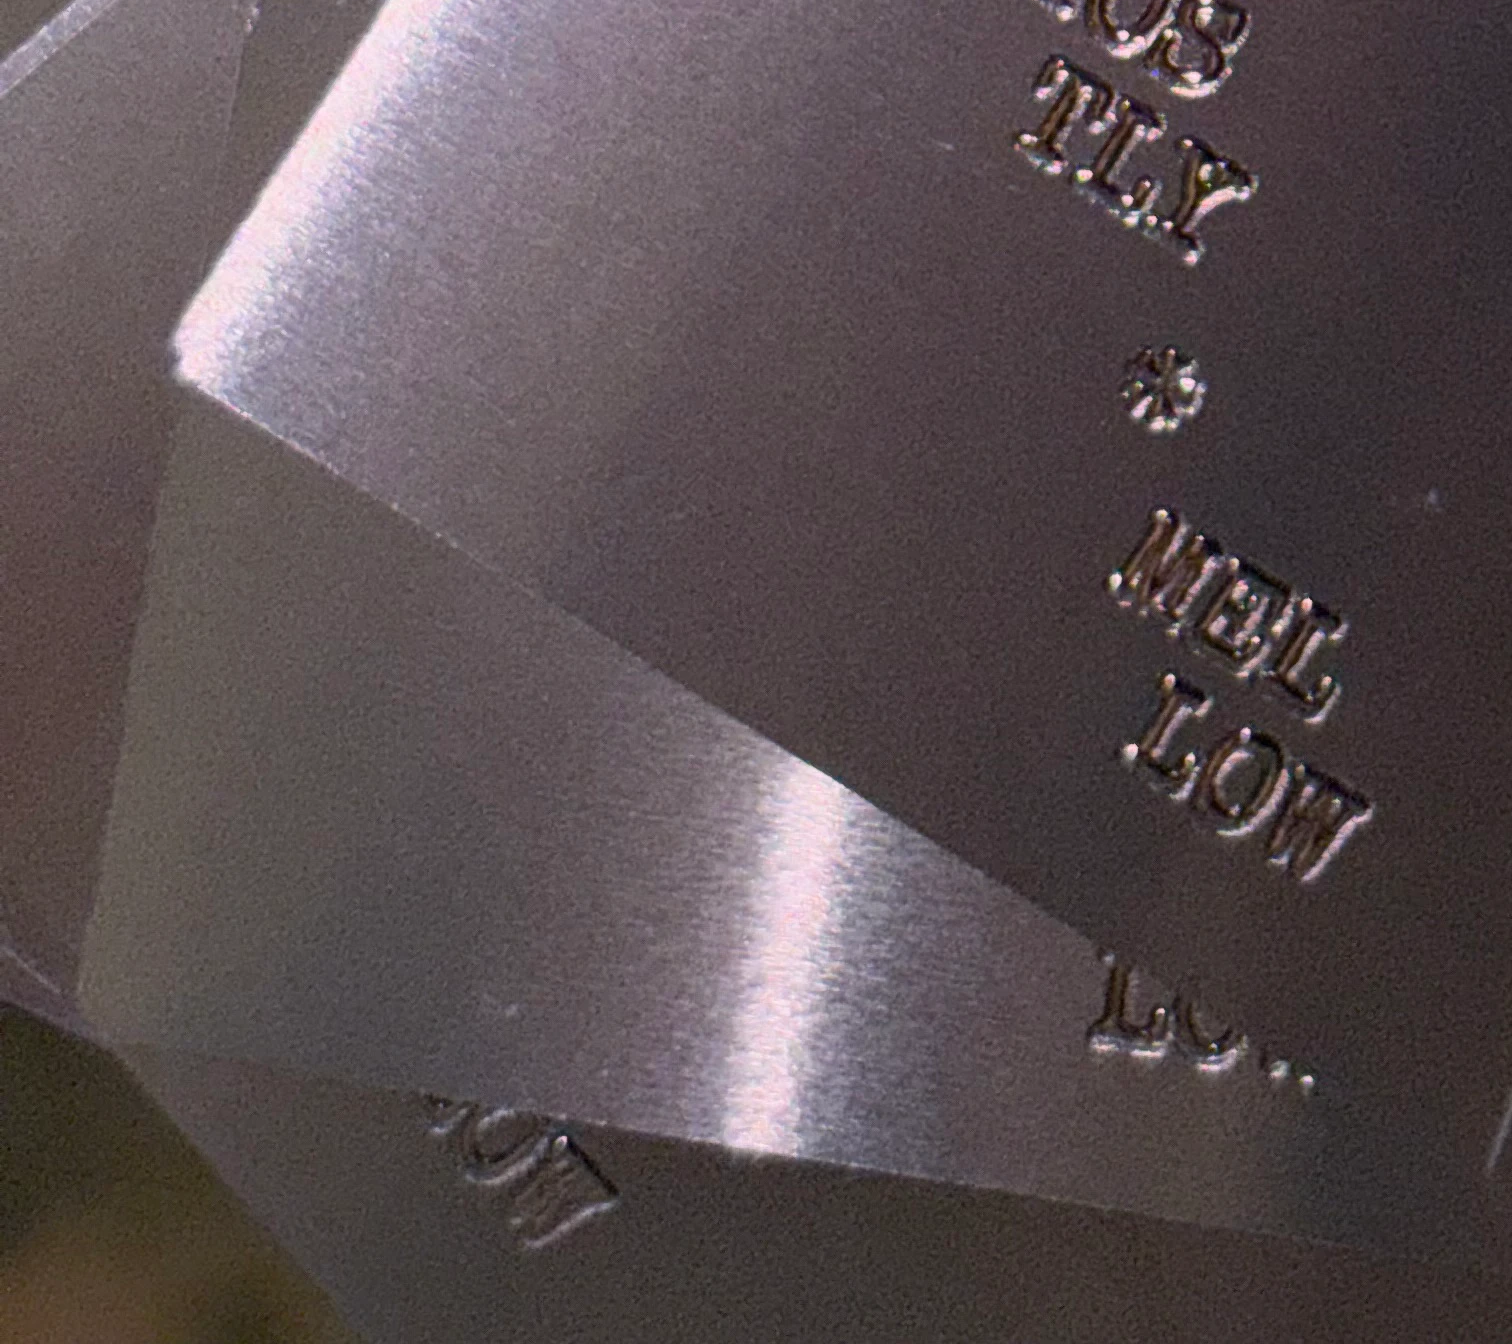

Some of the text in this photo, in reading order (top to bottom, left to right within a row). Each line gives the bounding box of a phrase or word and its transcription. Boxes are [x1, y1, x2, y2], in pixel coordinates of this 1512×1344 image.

[1013, 53, 1260, 267] TLY
[1104, 505, 1350, 726] MEL
[1116, 669, 1376, 885] LOW
[422, 1094, 622, 1252] OW
